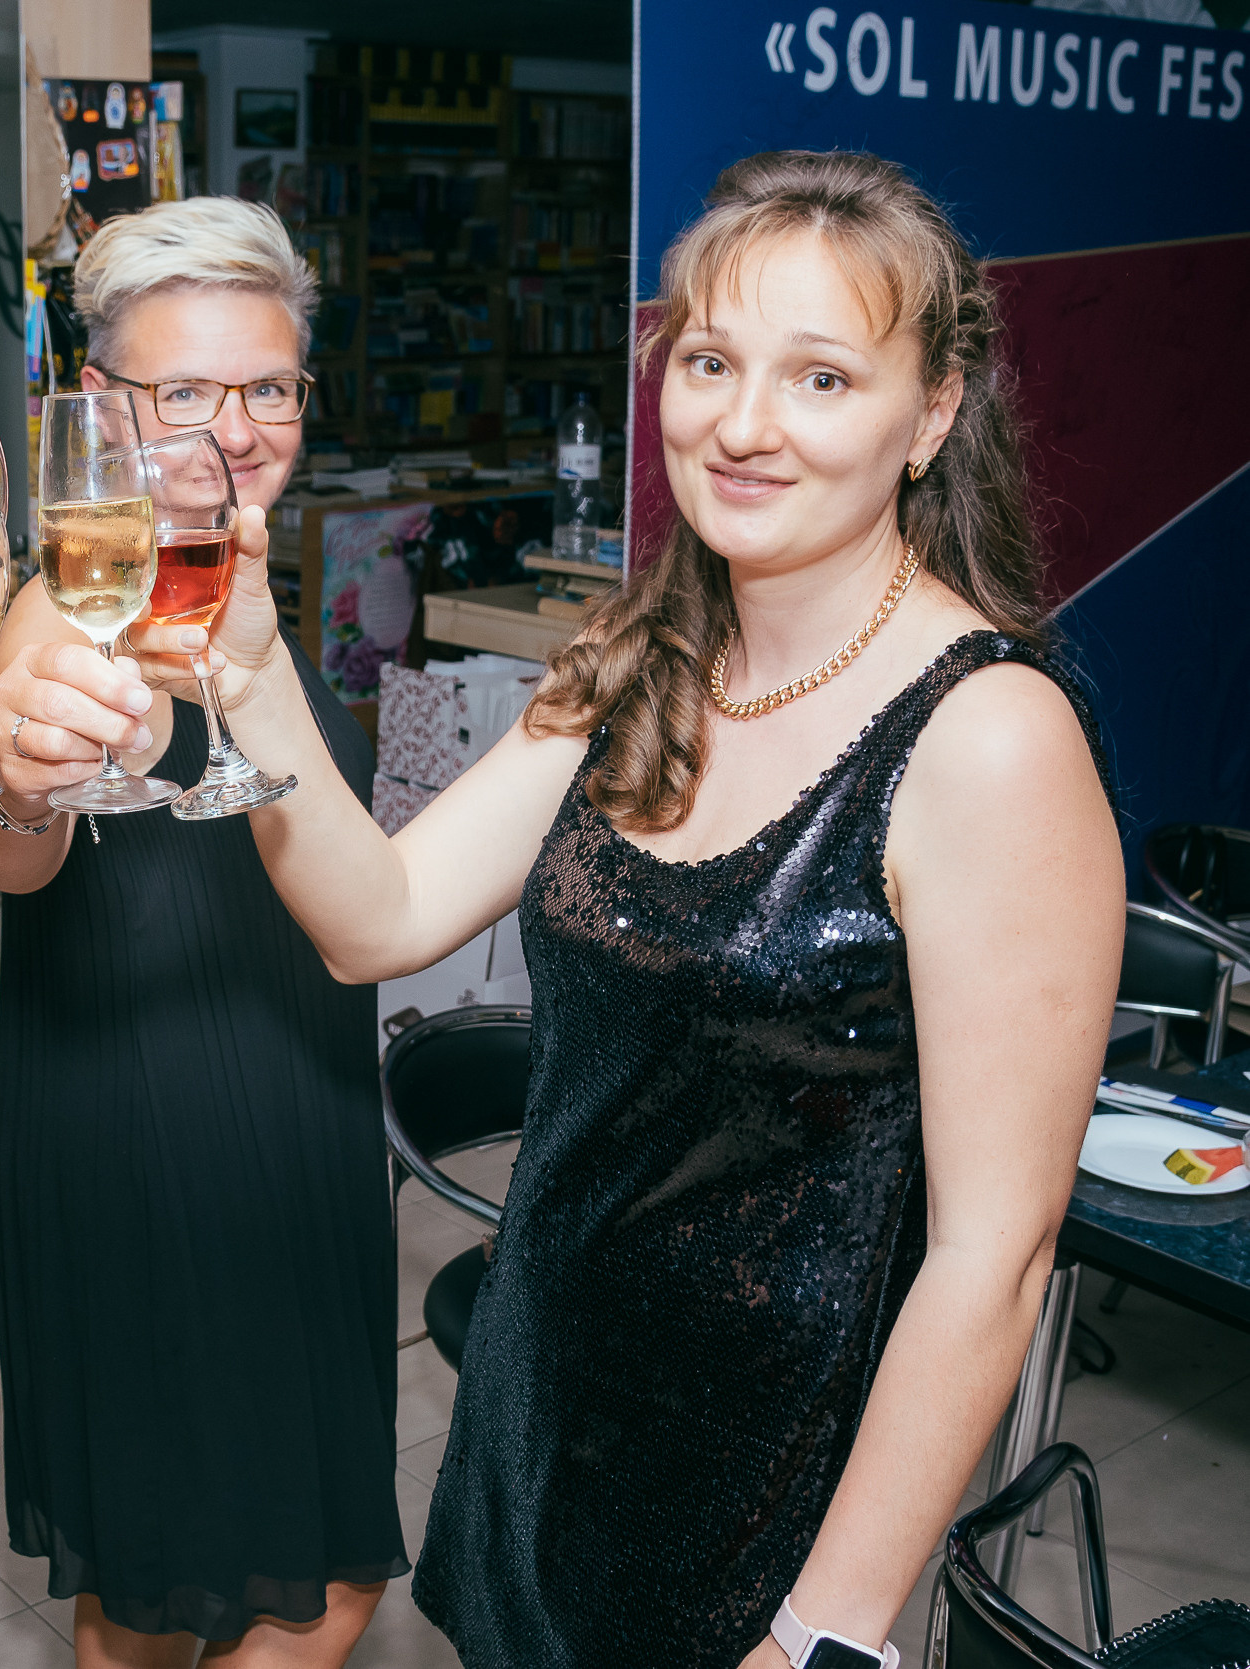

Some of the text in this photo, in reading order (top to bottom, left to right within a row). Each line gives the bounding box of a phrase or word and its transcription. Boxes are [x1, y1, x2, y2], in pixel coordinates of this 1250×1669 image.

[765, 6, 1247, 122] «SOL MUSIC FES
